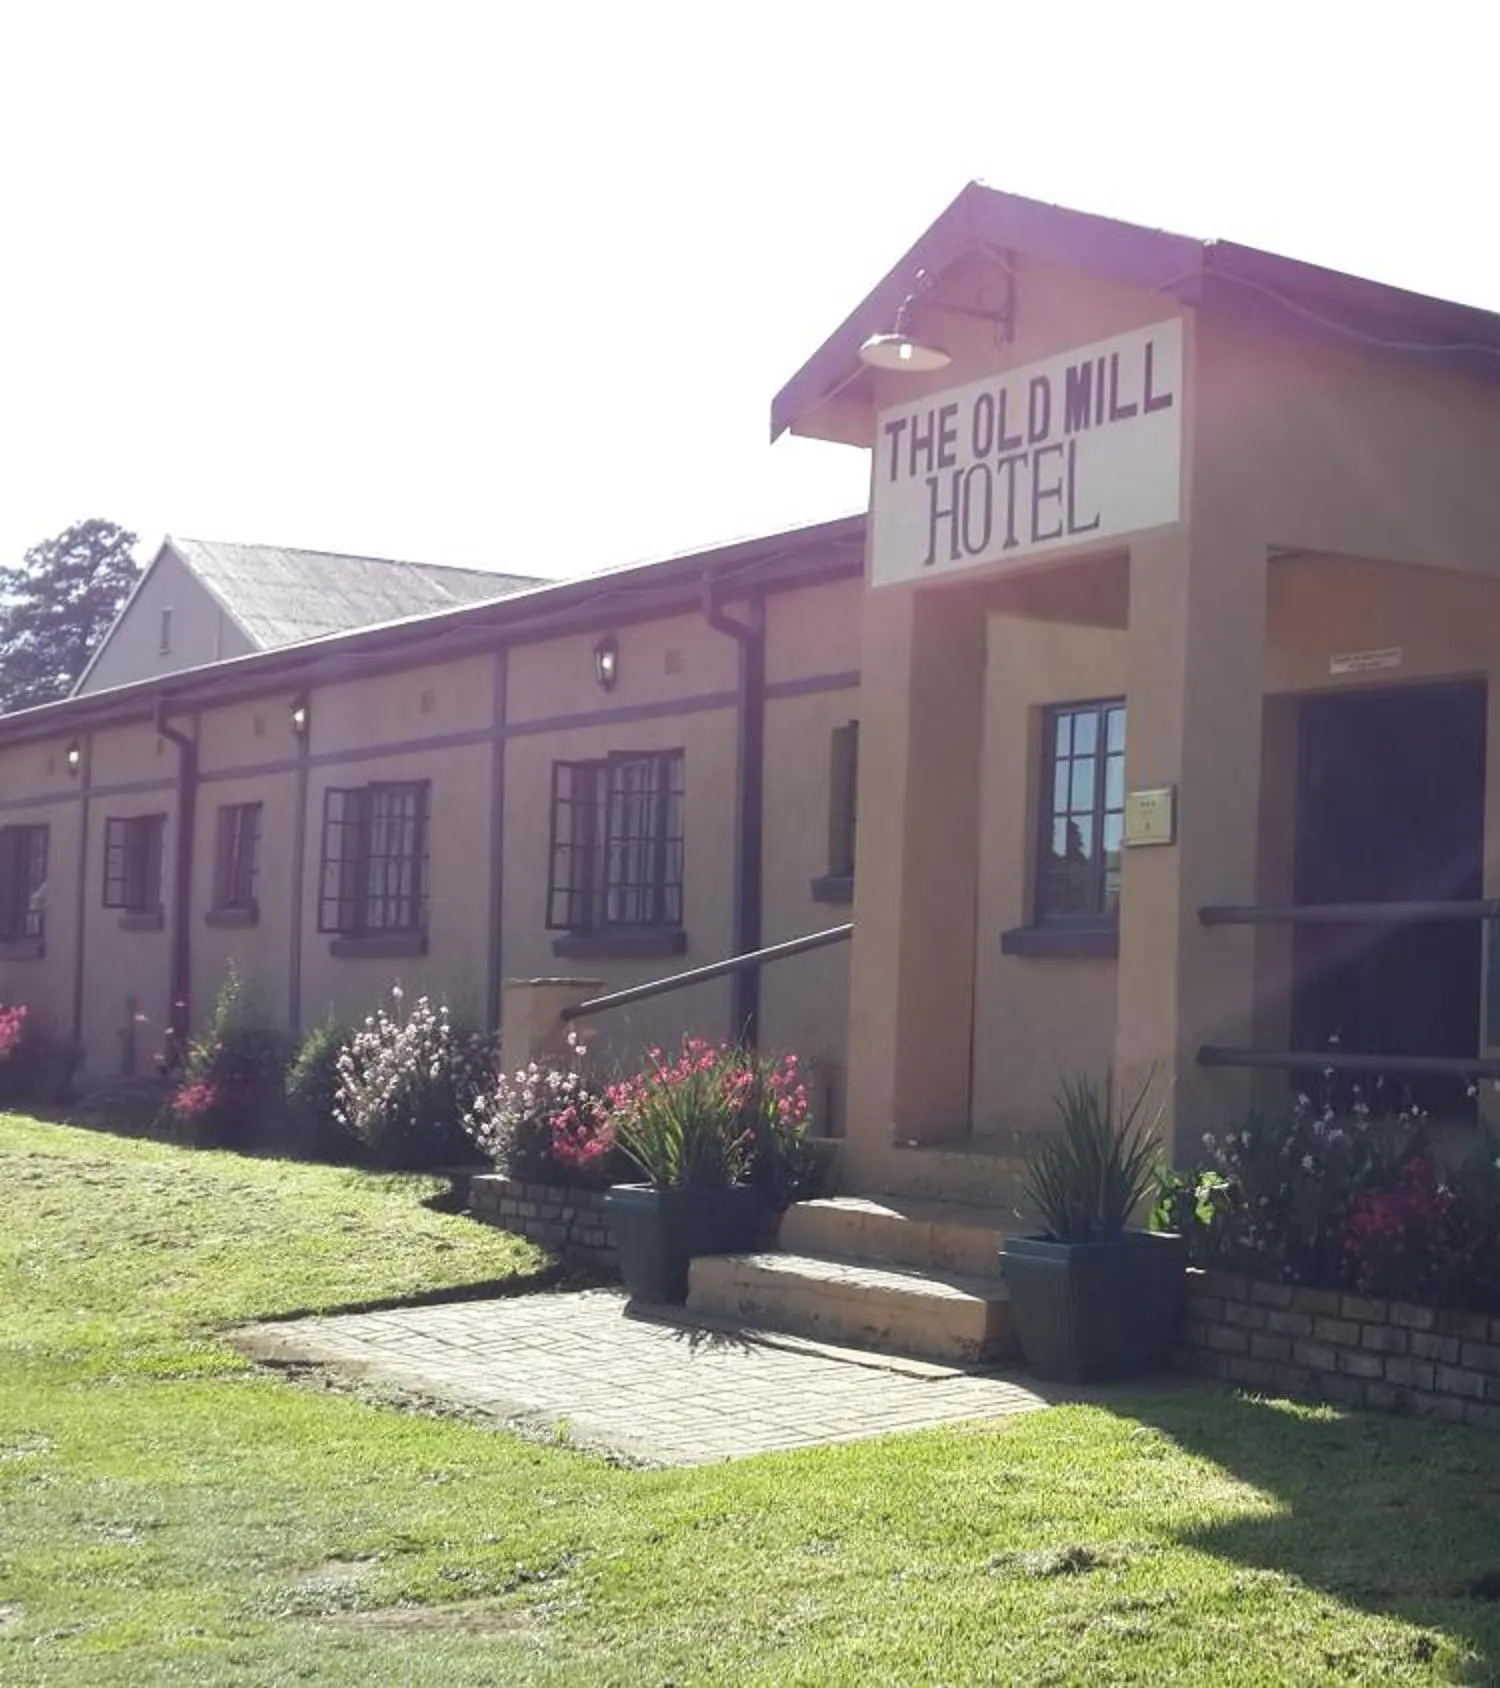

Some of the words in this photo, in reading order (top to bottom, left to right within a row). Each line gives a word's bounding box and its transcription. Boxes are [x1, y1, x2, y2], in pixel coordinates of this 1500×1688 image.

[885, 402, 959, 483] THE
[972, 374, 1051, 460] OLD
[1063, 340, 1174, 435] MILL
[923, 439, 1101, 567] HOTEL
